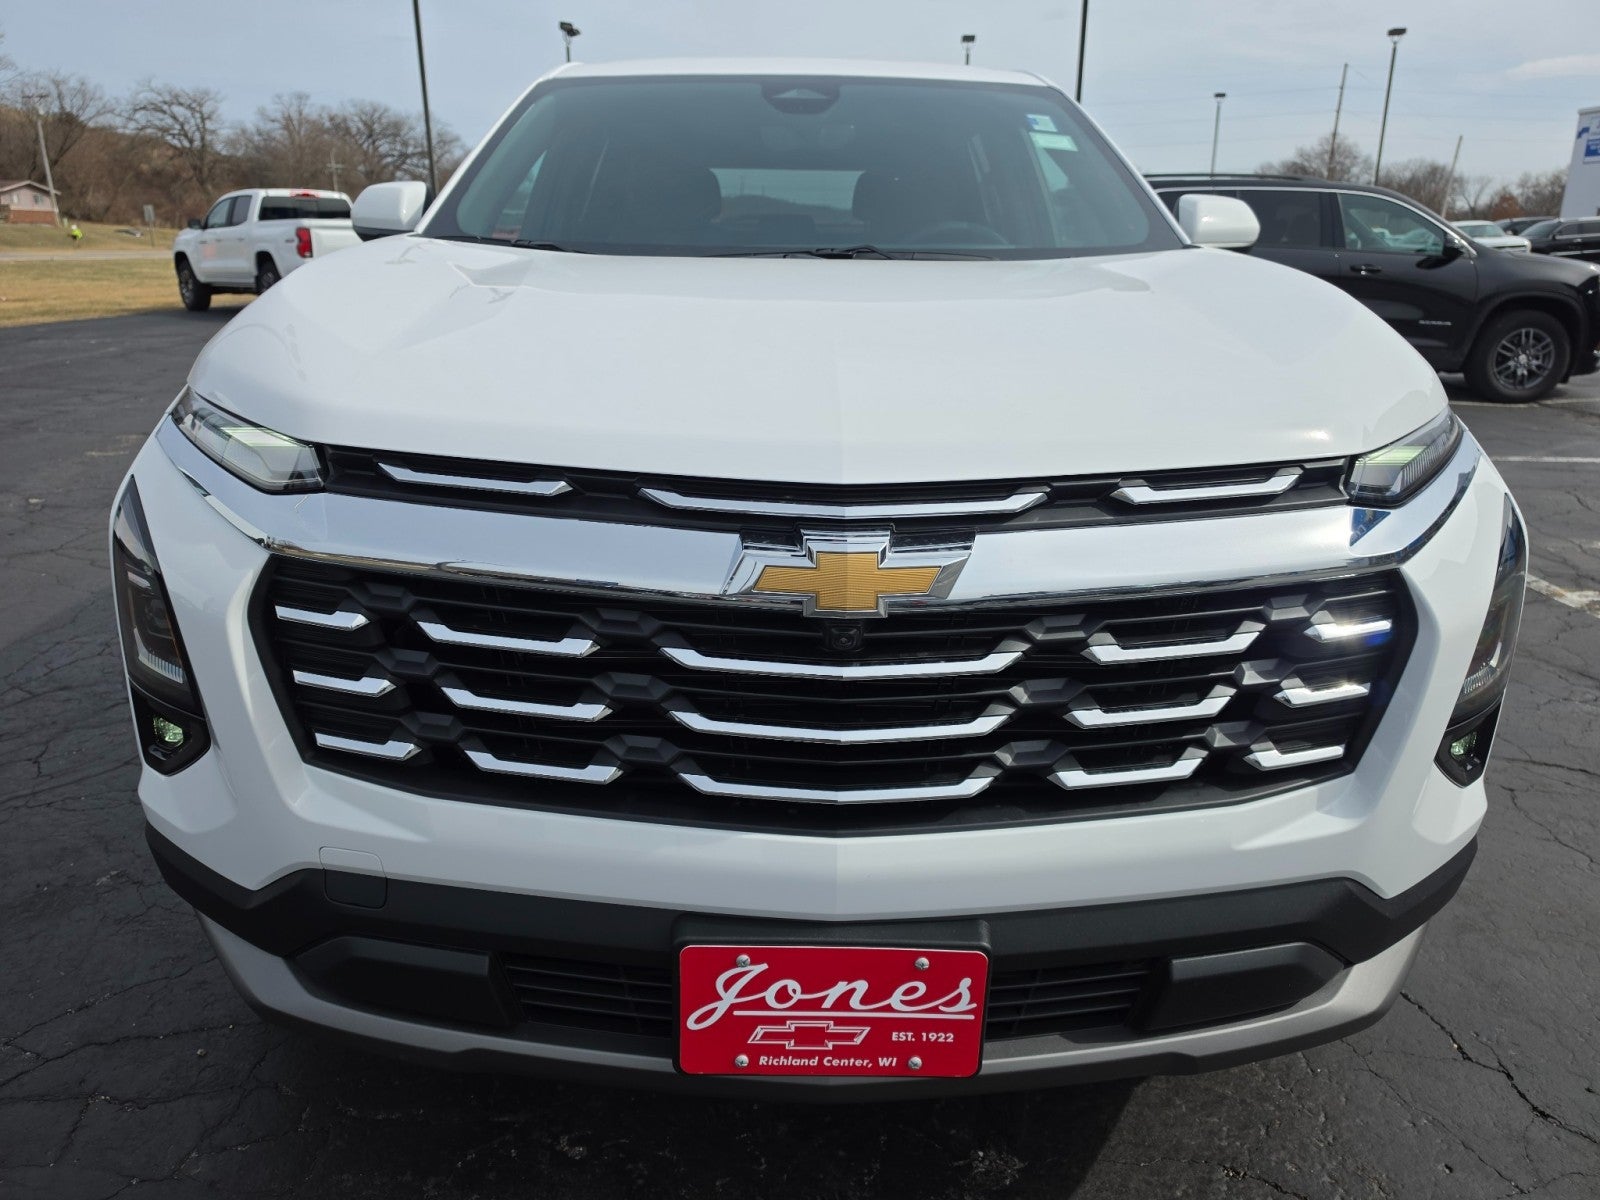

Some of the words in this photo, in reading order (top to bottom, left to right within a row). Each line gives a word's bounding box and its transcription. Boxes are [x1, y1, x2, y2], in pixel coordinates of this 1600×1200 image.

[686, 962, 978, 1031] Jones
[891, 1031, 916, 1042] EST.
[921, 1032, 955, 1043] 1922
[758, 1055, 819, 1067] Richland
[822, 1056, 873, 1068] Center,
[878, 1057, 897, 1067] WI
